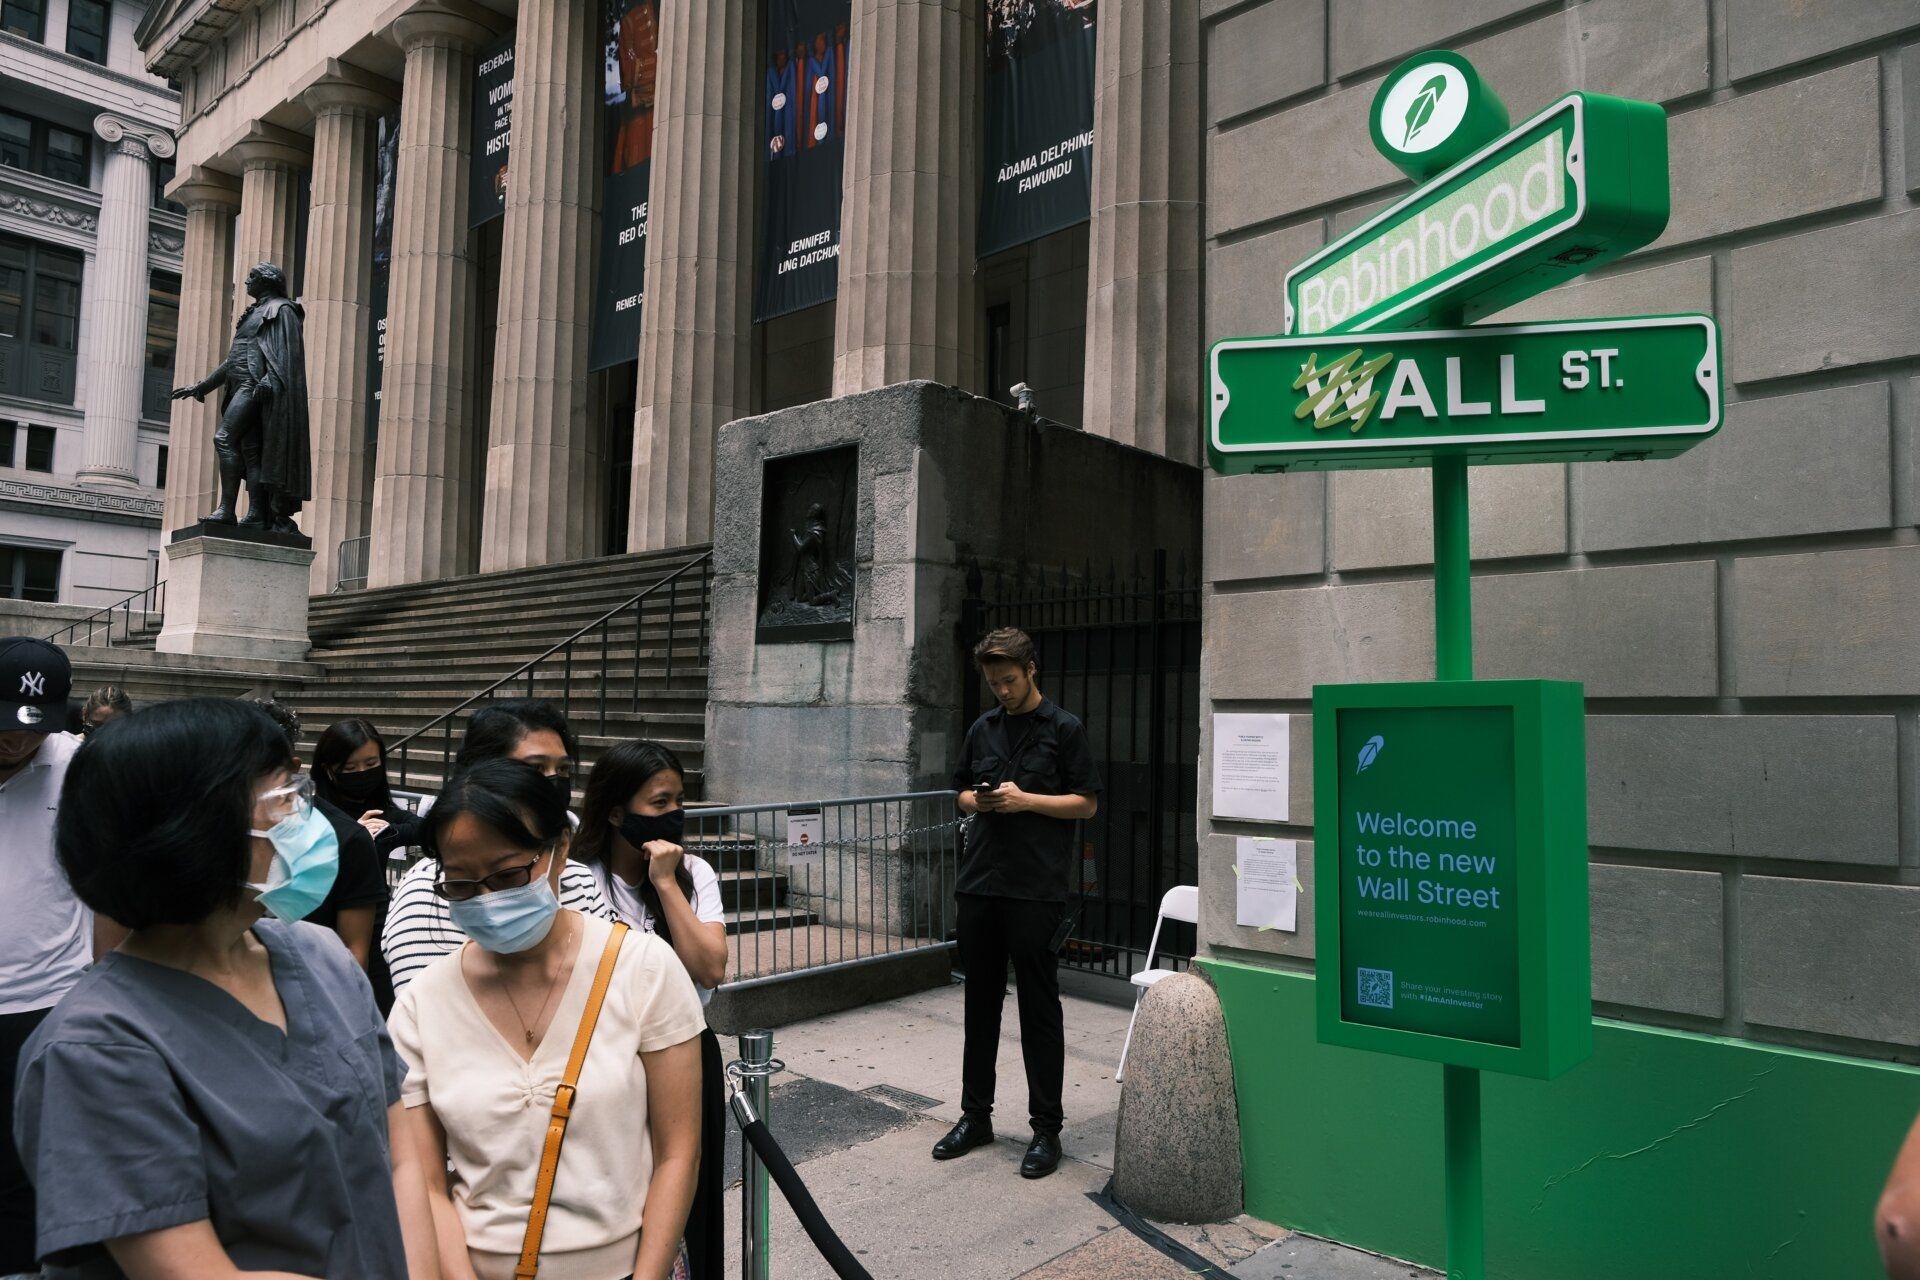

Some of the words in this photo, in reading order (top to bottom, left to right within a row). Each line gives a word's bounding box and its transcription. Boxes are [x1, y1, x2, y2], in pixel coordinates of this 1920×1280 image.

[479, 48, 514, 77] FEDERAL
[495, 116, 508, 131] FACE
[497, 105, 504, 117] IN
[997, 154, 1038, 183] ADAMA
[1040, 129, 1095, 166] DELPHINE
[1018, 158, 1072, 194] FAWUNDU
[631, 202, 648, 221] THE
[619, 226, 636, 246] RED
[788, 230, 831, 255] JENNIFER
[1303, 135, 1557, 334] Robinhood
[778, 257, 798, 275] LING
[800, 243, 840, 268] DATCHUK
[615, 295, 638, 312] RENEE
[1299, 354, 1546, 421] WALL
[1562, 348, 1624, 390] ST.
[19, 671, 46, 697] NY
[1356, 811, 1477, 840] Welcome
[1356, 845, 1381, 867] to
[1388, 845, 1431, 870] the
[1439, 853, 1496, 875] new
[1357, 875, 1409, 902] Wall
[1417, 880, 1500, 909] Street
[1357, 909, 1487, 928] weareallinvestors.robinhood.com
[1400, 981, 1423, 991] Share
[1424, 985, 1442, 994] your
[1443, 986, 1480, 1001] investing
[1481, 992, 1503, 1003] story
[1400, 992, 1418, 1000] with
